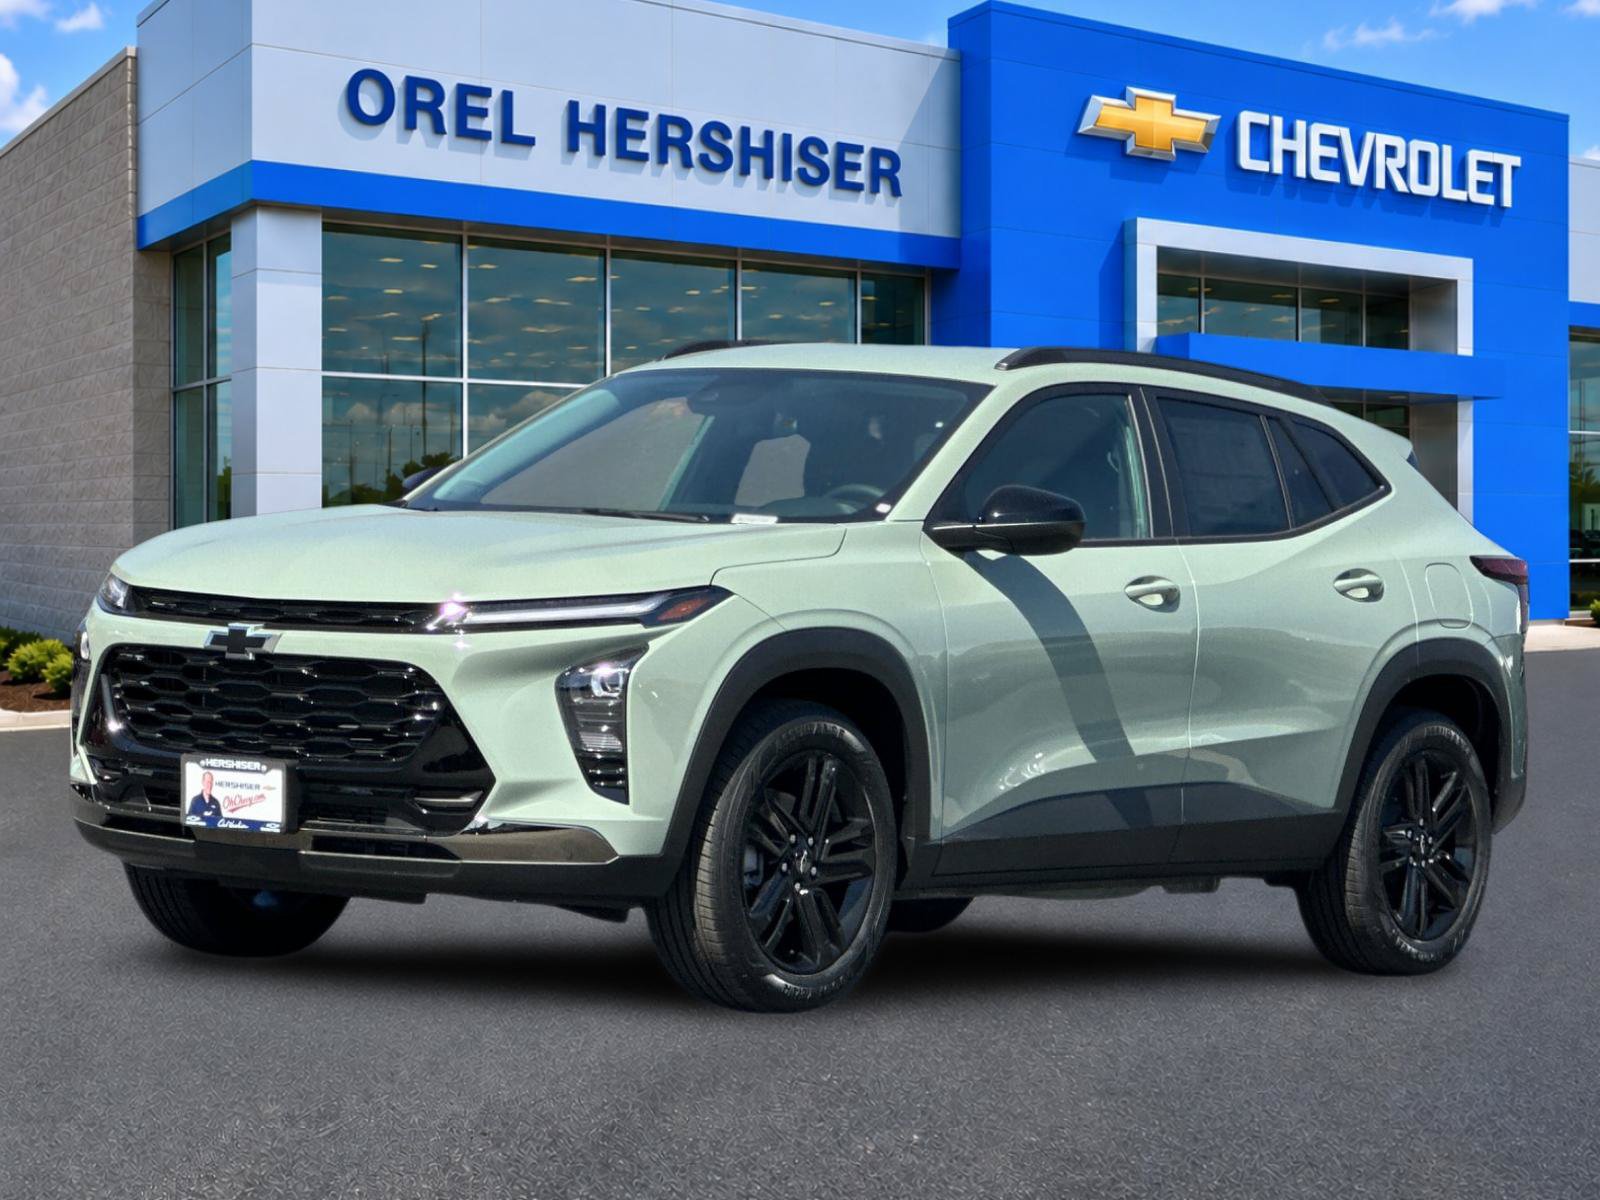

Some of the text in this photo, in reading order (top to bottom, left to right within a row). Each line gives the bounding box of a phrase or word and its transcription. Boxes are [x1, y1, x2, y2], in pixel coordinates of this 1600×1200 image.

[346, 68, 902, 198] OREL HERSHISER
[1237, 110, 1521, 208] CHEVROLET
[205, 758, 261, 771] HERSHISER
[215, 781, 261, 790] HERSHISER
